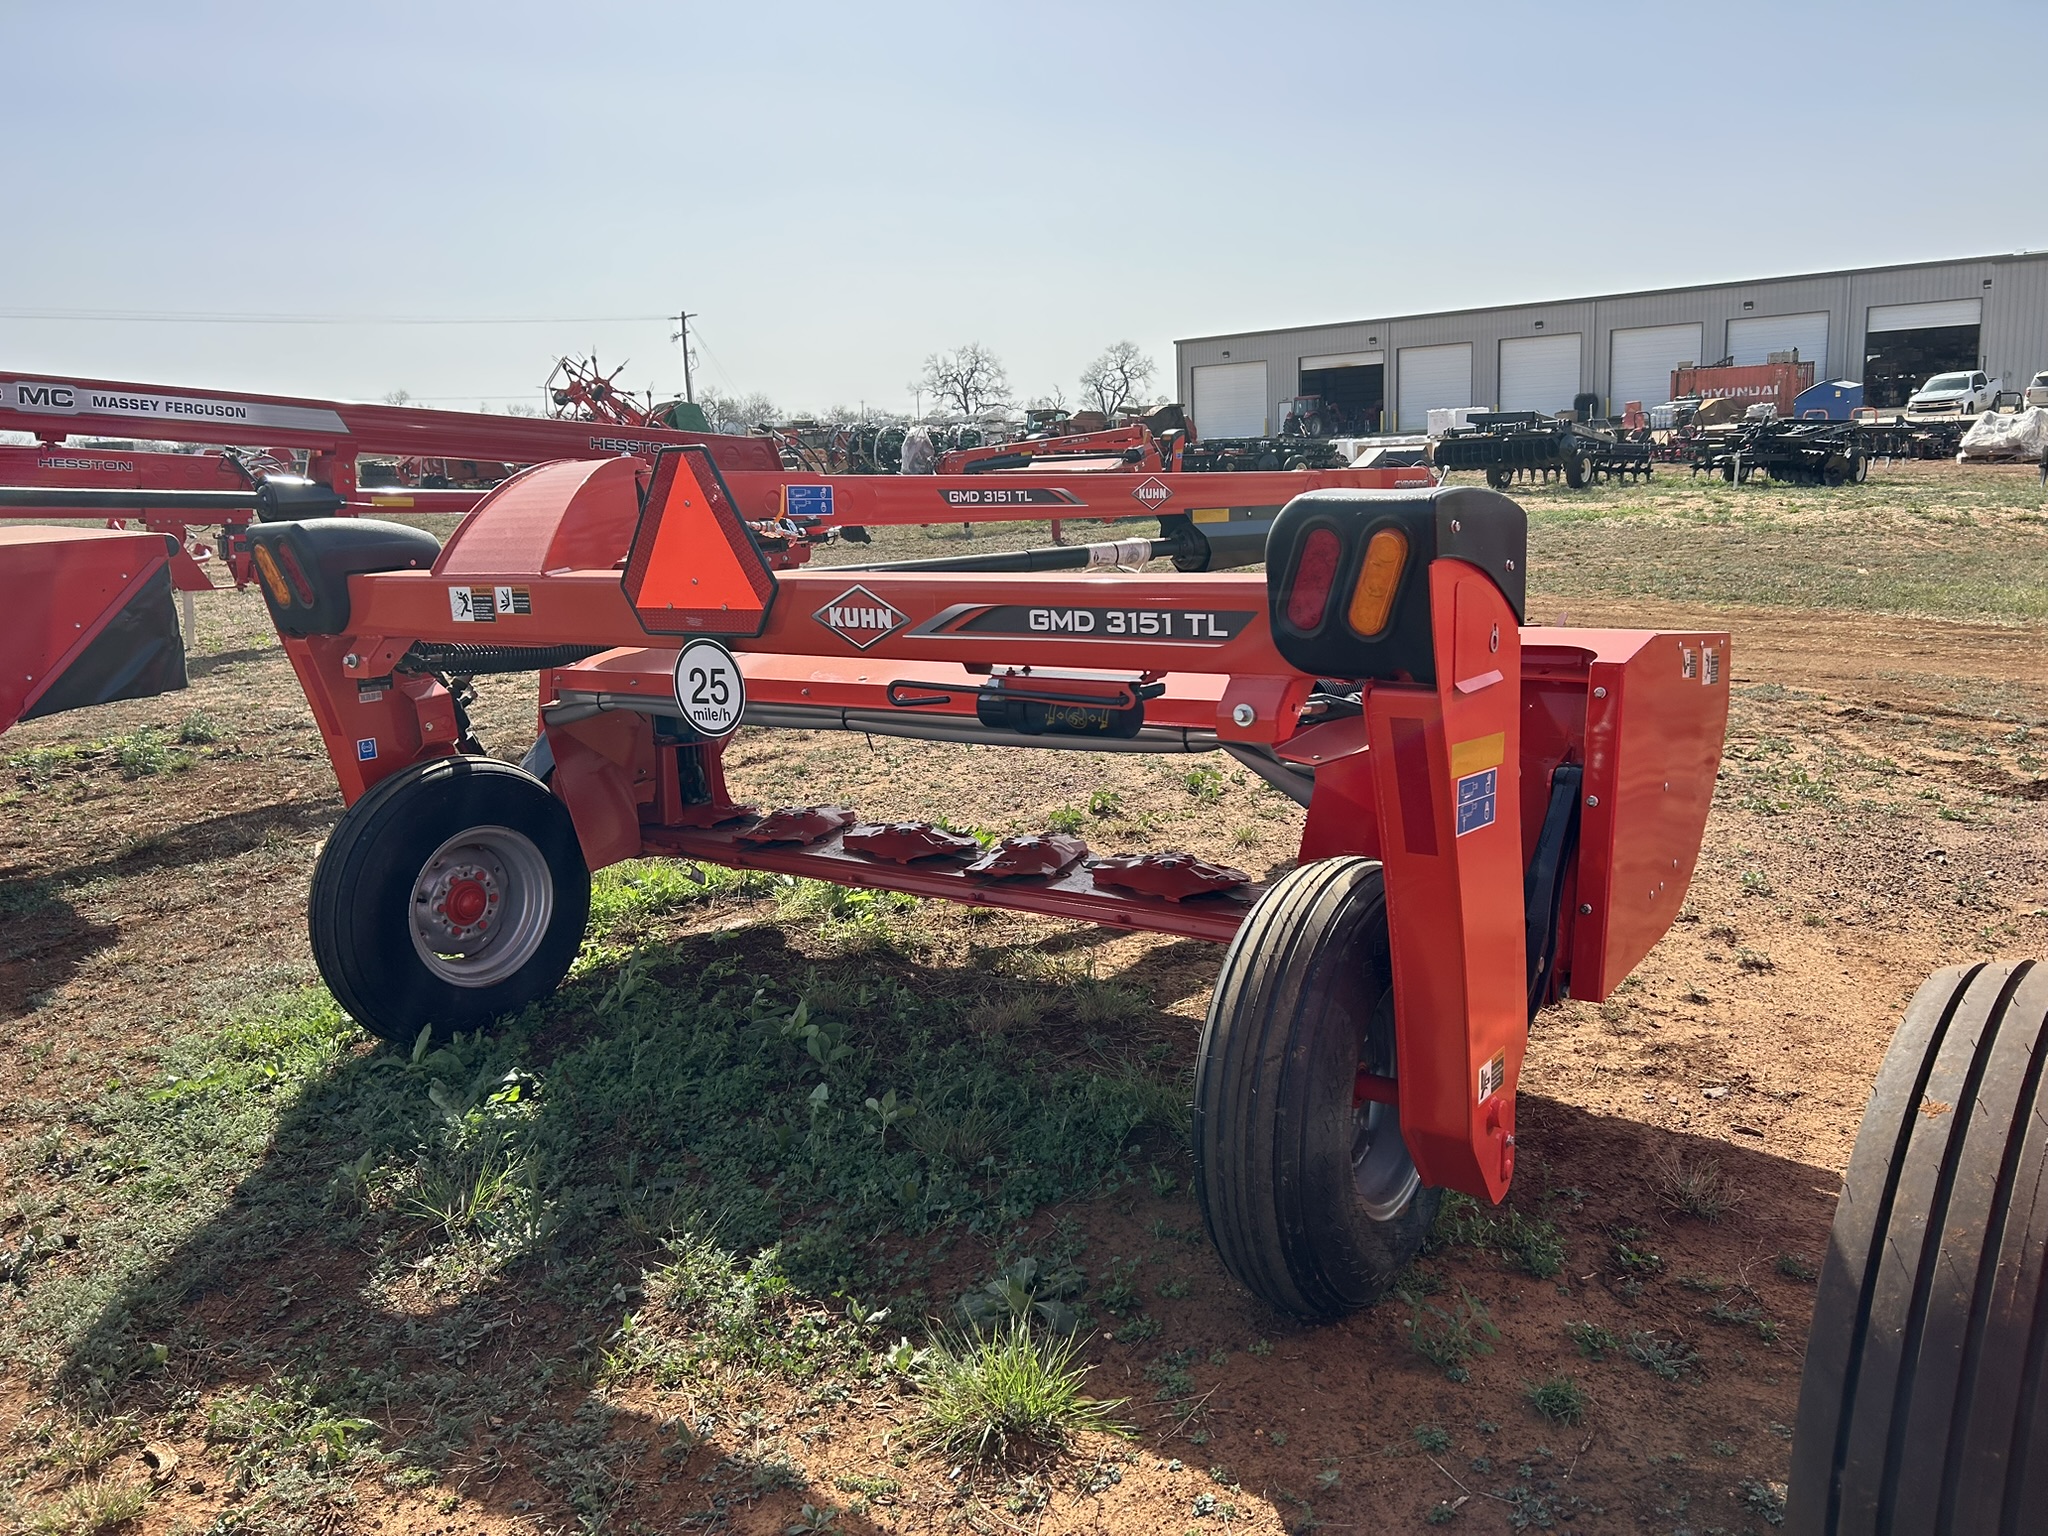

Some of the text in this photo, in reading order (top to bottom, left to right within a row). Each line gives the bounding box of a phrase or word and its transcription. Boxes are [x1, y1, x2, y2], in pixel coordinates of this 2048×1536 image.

[18, 386, 74, 407] MC
[1701, 384, 1779, 399] HYUNDAI
[92, 395, 247, 419] MASSEY FERGUSON
[590, 436, 677, 454] HESSTO
[38, 458, 133, 472] HESSTON
[949, 490, 1033, 503] GMD 3151 TL
[1138, 488, 1167, 500] KUHN
[828, 606, 893, 629] KUHN
[1029, 609, 1229, 637] GMD 3151 TL
[689, 667, 730, 705] 25
[693, 707, 731, 722] mile/h
